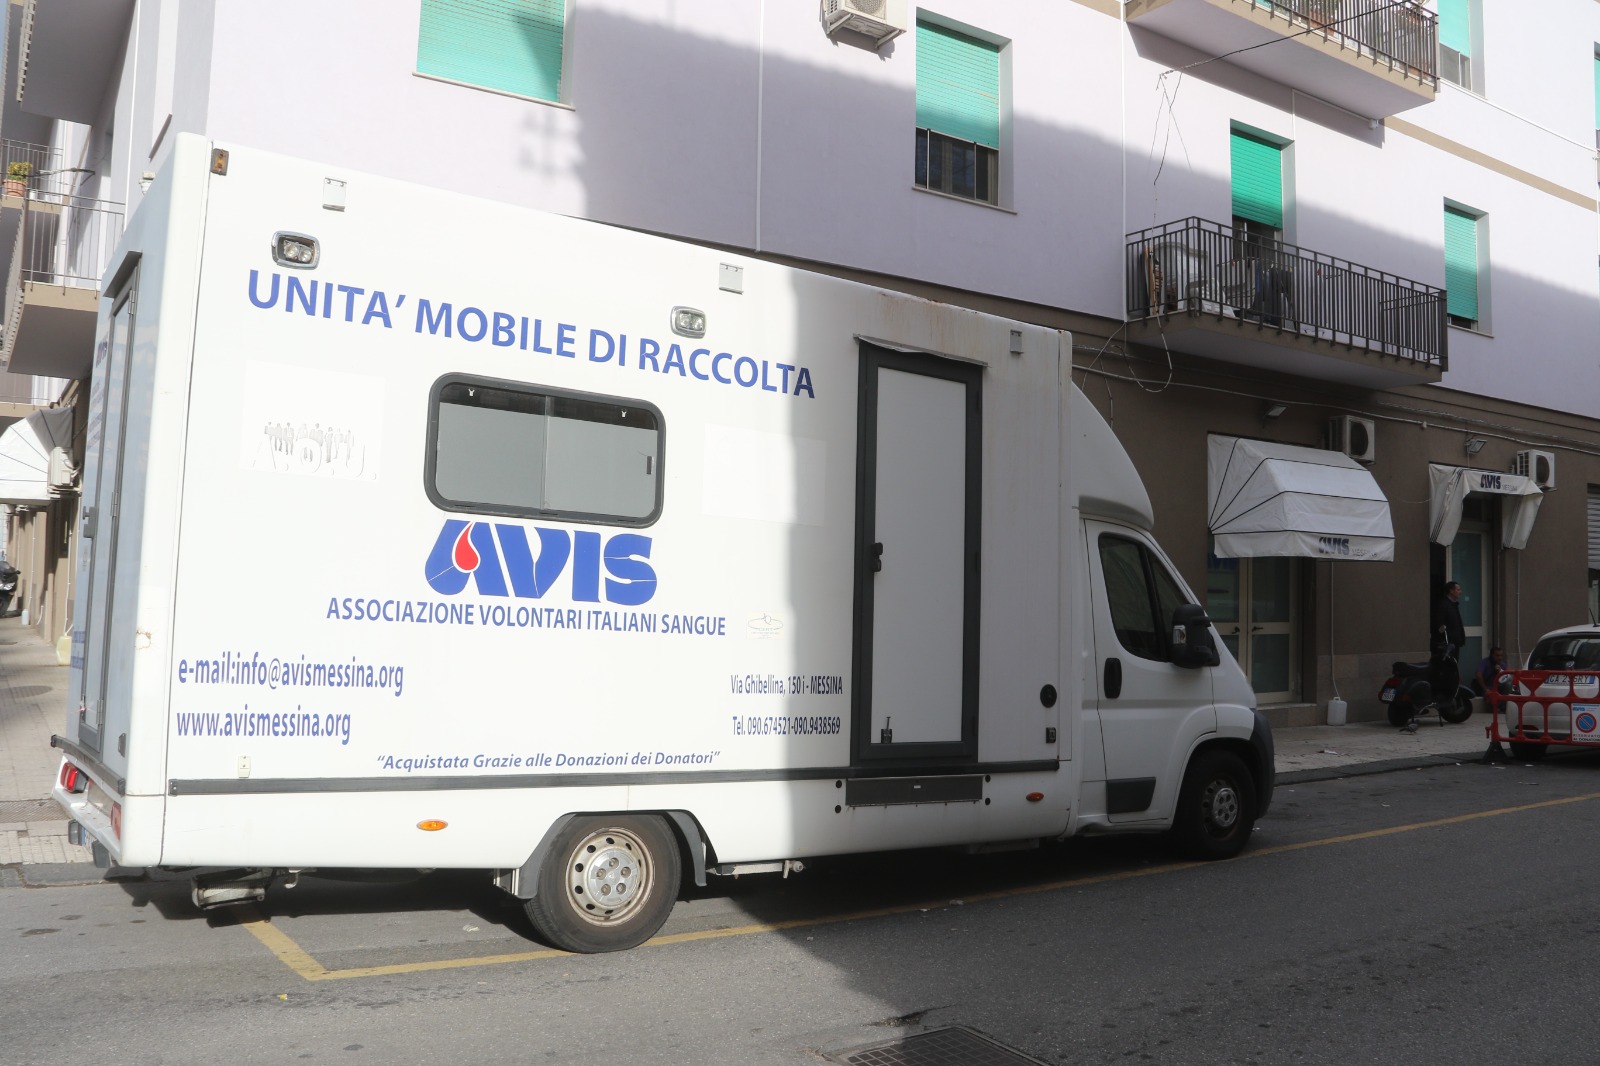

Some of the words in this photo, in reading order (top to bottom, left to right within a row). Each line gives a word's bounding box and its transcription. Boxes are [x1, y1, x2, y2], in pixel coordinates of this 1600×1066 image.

[414, 298, 577, 359] MOBILE
[588, 328, 627, 367] DI
[638, 337, 815, 399] RACCOLTA
[1480, 473, 1501, 490] AVIS
[424, 518, 658, 606] AVIS
[326, 597, 475, 626] ASSOCIAZIONE
[479, 604, 582, 630] VOLONTARI
[586, 610, 657, 633] ITALIANI
[661, 613, 726, 636] SANGUE
[178, 651, 404, 697] e-mail:info@avismessina.org
[731, 674, 743, 694] Via
[745, 674, 786, 697] Ghibellina,
[788, 676, 801, 694] 150
[810, 676, 843, 695] MESSINA
[177, 704, 351, 745] www.avismessina.org
[732, 715, 746, 736] Tel.
[473, 754, 523, 768] Grazie
[526, 753, 553, 767] alle
[556, 752, 629, 767] Donazioni
[631, 752, 653, 766] dei
